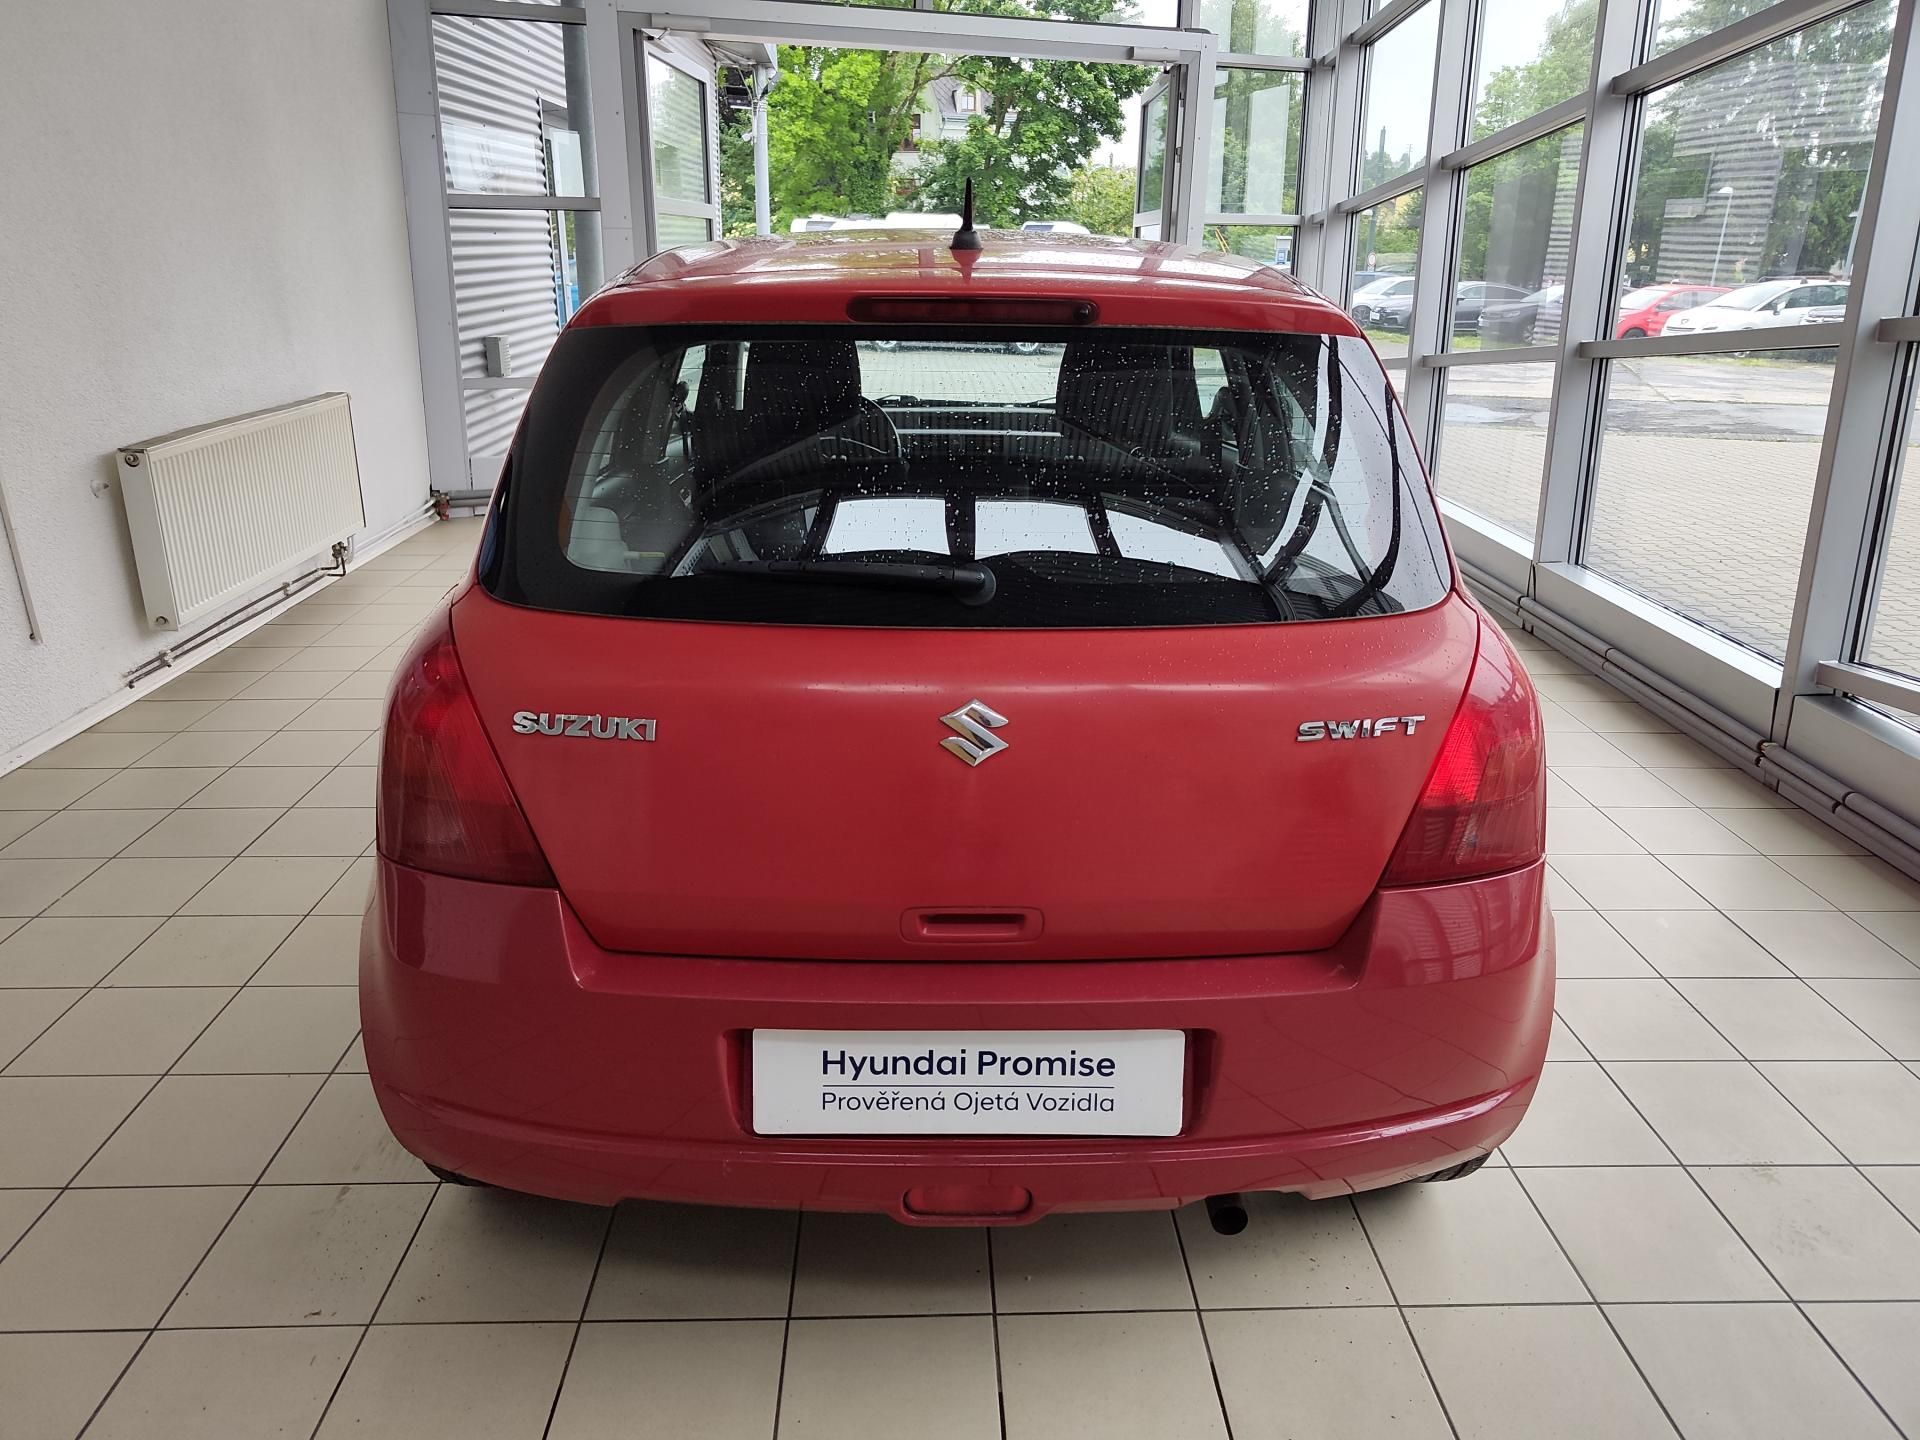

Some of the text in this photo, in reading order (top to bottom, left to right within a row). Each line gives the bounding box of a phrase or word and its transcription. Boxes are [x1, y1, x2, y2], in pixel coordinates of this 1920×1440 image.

[512, 711, 657, 742] SUZUKI
[1296, 715, 1426, 742] SWIFT
[822, 1048, 1116, 1081] Hyundai Promise
[822, 1090, 1114, 1116] Prověřená Ojetá Vozidla
